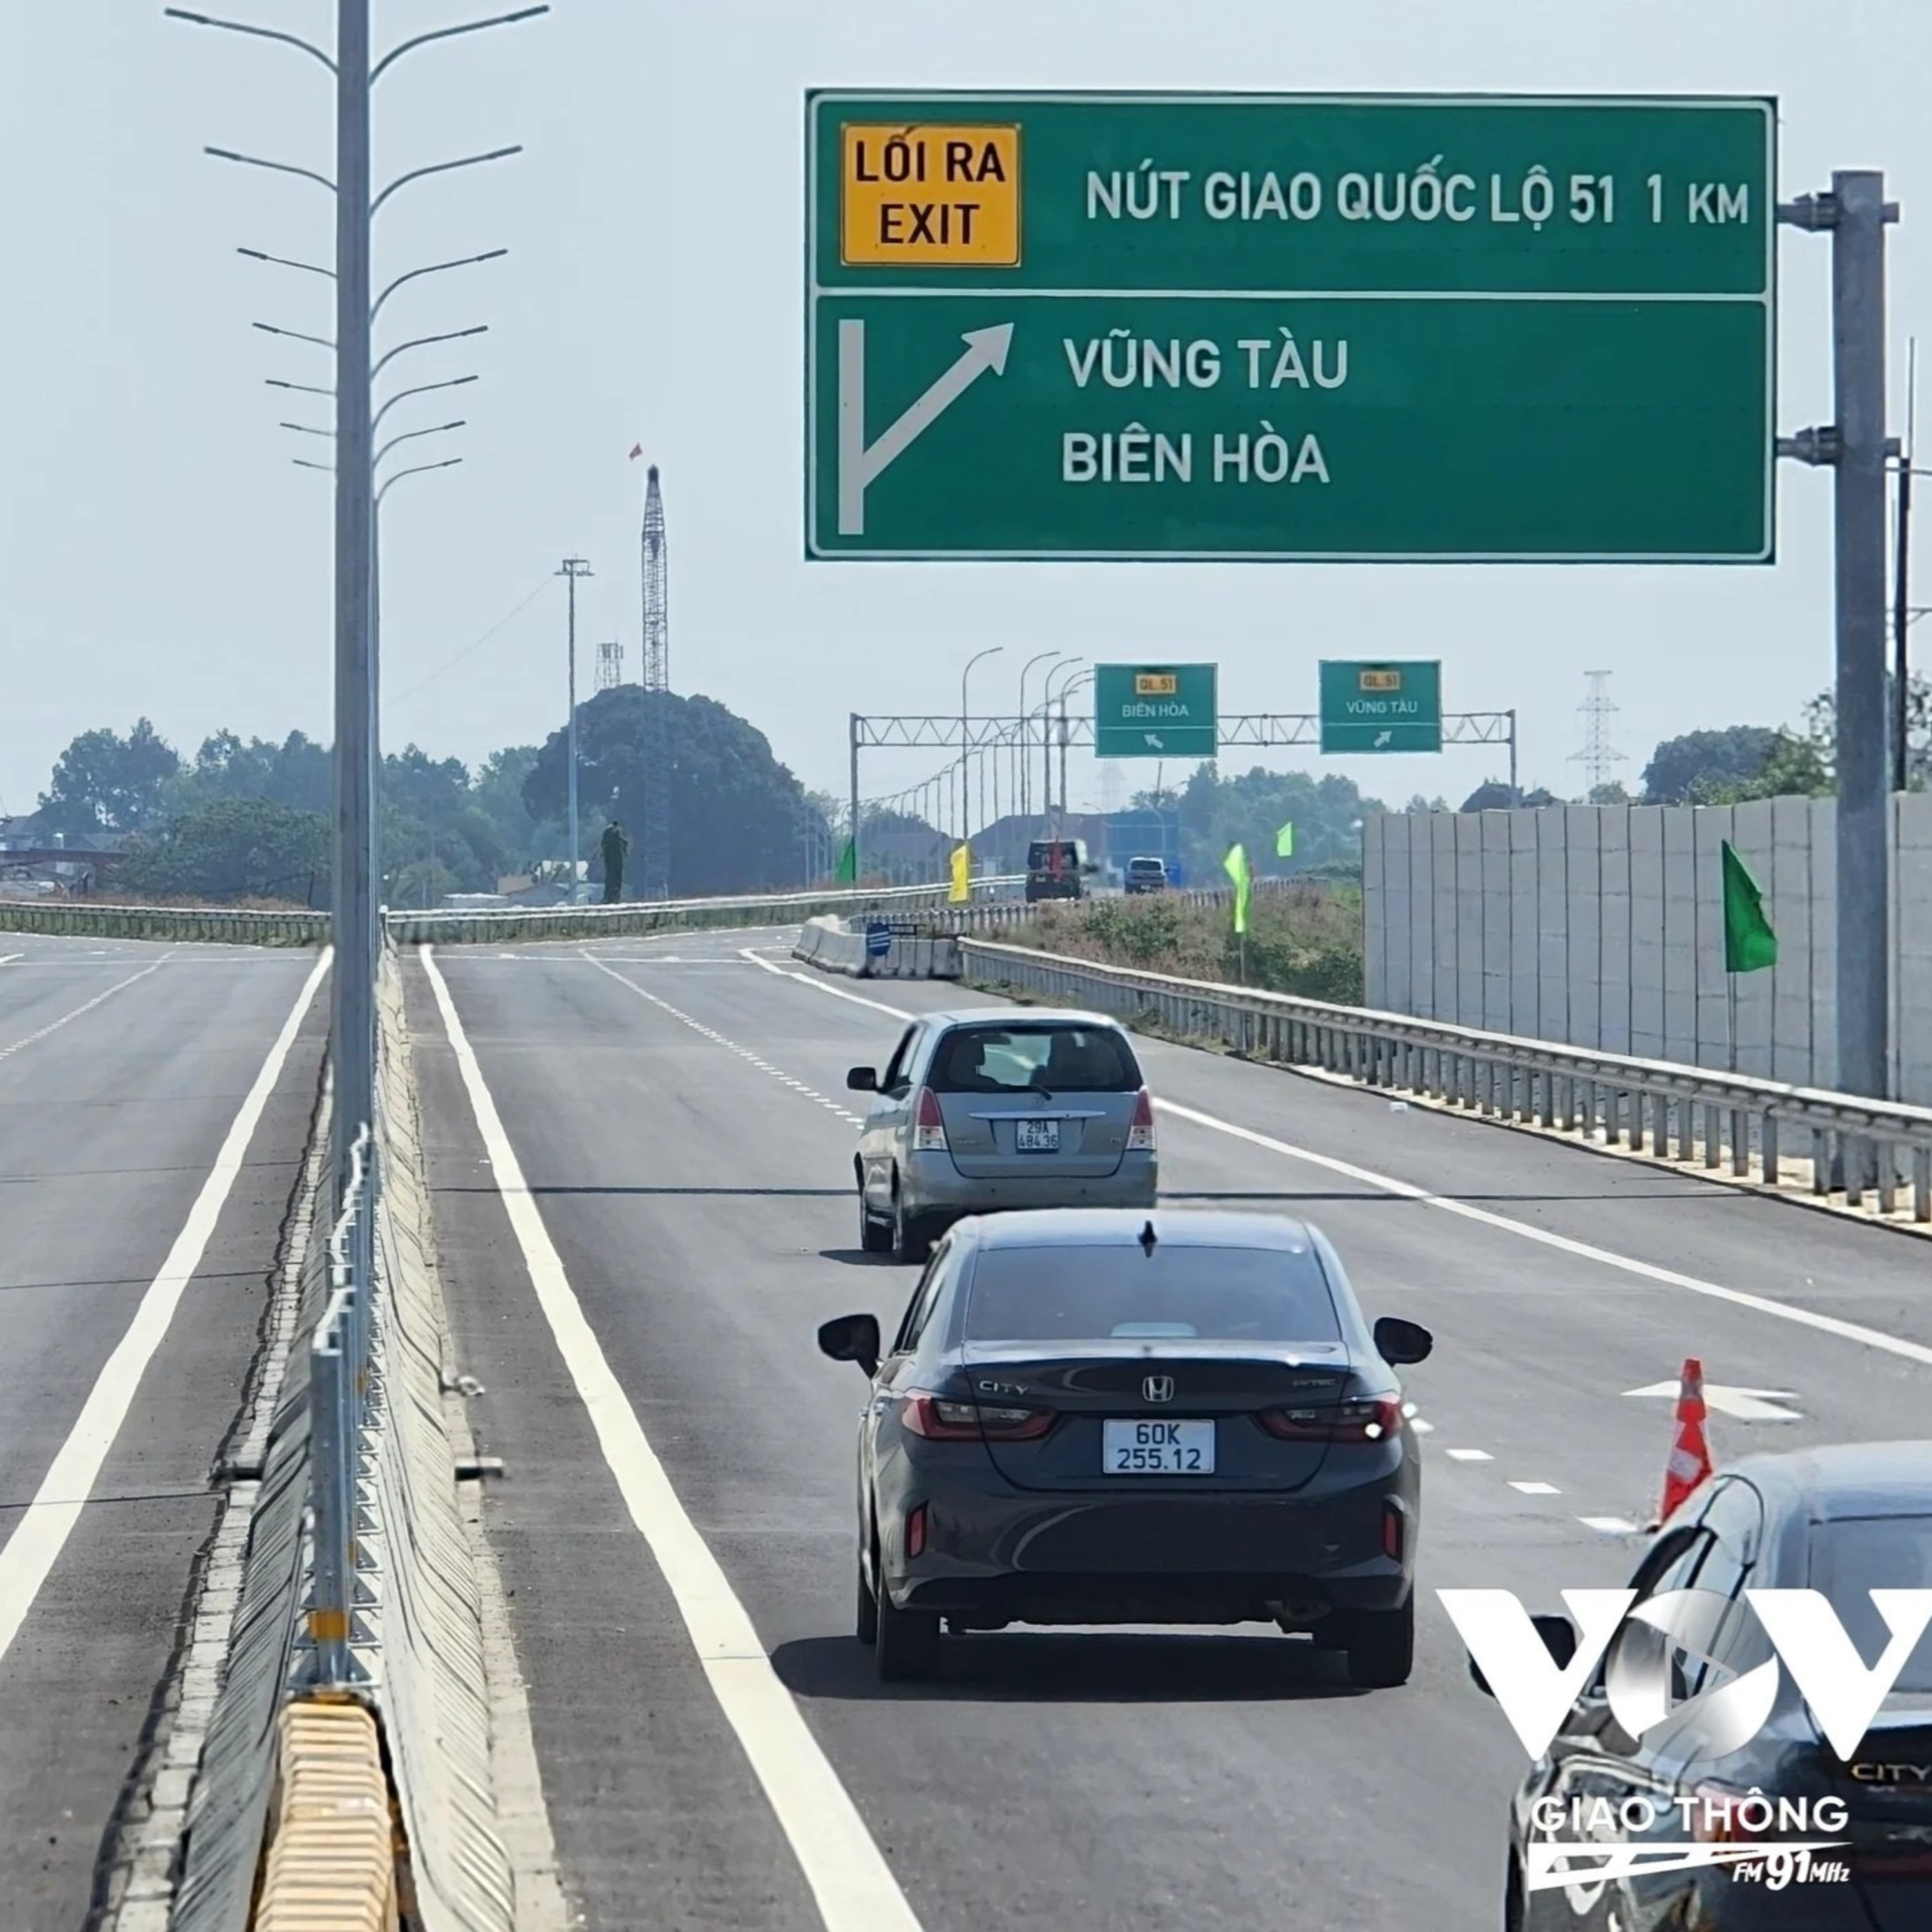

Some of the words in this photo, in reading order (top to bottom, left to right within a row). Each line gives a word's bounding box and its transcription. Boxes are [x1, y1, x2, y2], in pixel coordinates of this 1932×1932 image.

[856, 126, 925, 182] LỐI
[946, 142, 1005, 182] RA
[1088, 158, 1189, 219] NÚT
[1205, 172, 1321, 220] GIAO
[1338, 155, 1475, 221] QUỐC
[1492, 164, 1553, 231] LỘ
[1571, 175, 1613, 223] 51
[1648, 175, 1661, 222] 1
[1689, 184, 1747, 223] KM
[880, 204, 980, 245] EXIT
[1064, 328, 1220, 388] VŨNG
[1238, 327, 1347, 388] TÀU
[1063, 421, 1191, 482] BIÊN
[1214, 420, 1329, 482] HÒA
[1122, 701, 1155, 717] BIÊN
[1159, 700, 1189, 717] HÒA
[1389, 697, 1418, 714] TÀU
[1027, 1121, 1049, 1134] 29A
[980, 1380, 1030, 1396] CITY
[1136, 1423, 1180, 1444] 60K
[1117, 1448, 1200, 1470] 255.12
[1851, 1763, 1932, 1781] CITY
